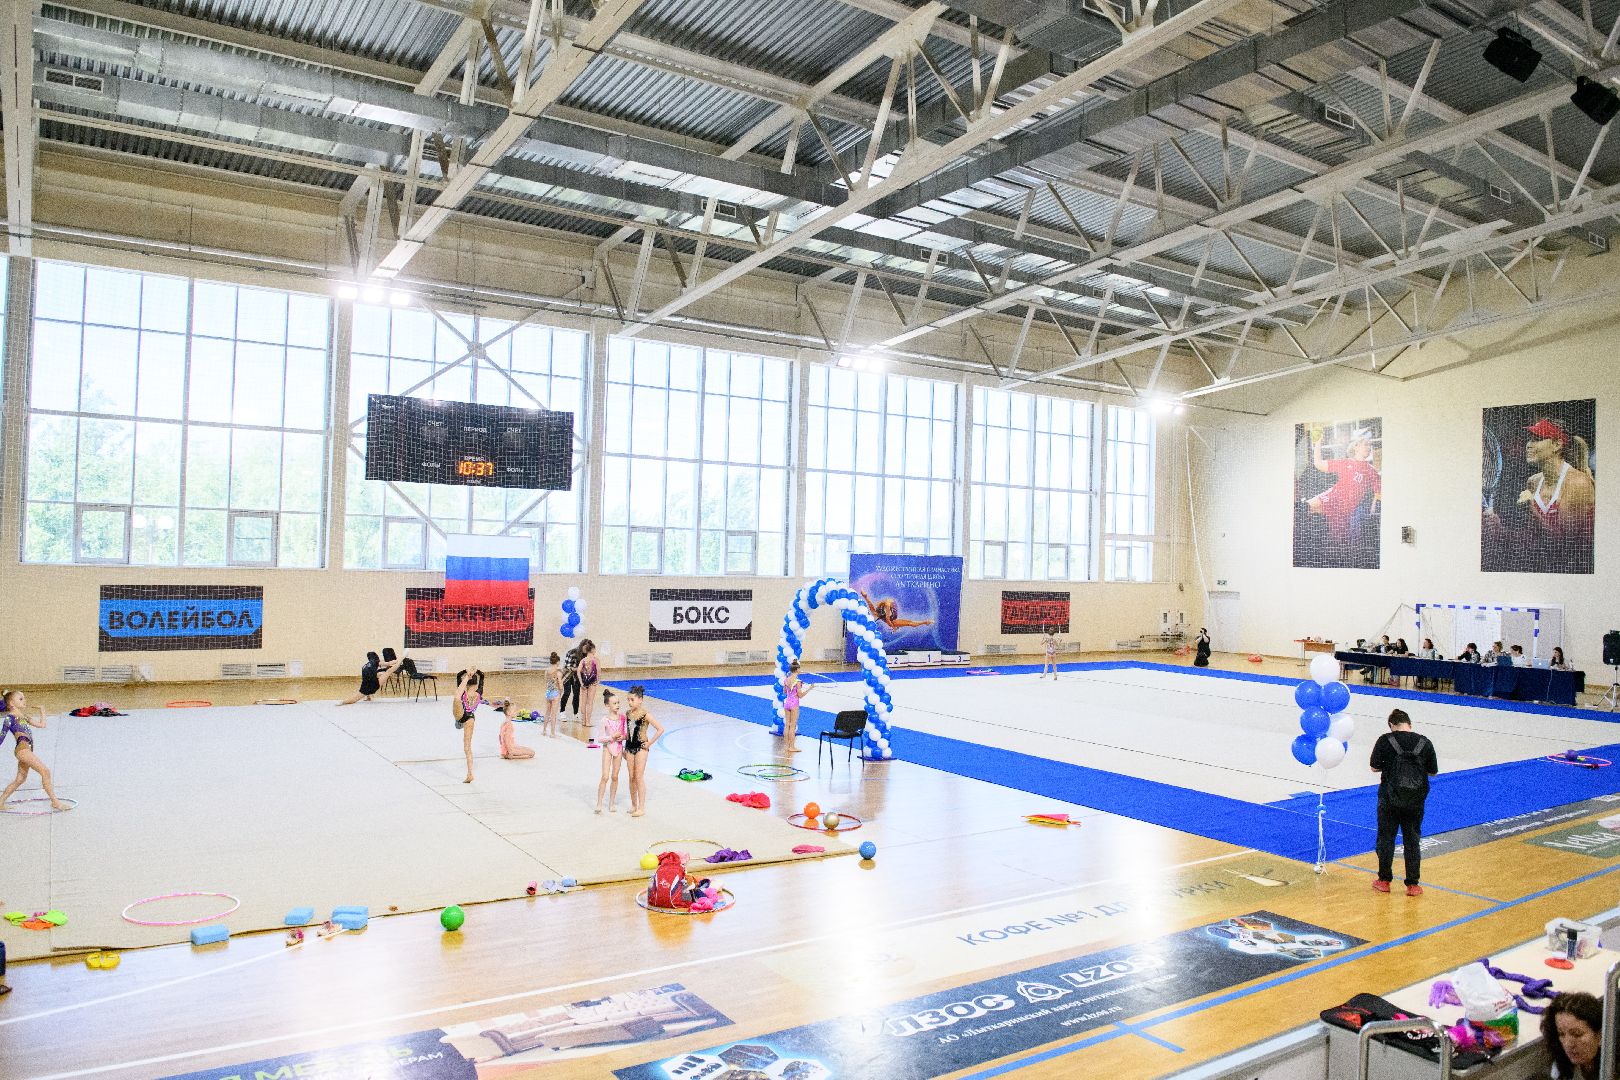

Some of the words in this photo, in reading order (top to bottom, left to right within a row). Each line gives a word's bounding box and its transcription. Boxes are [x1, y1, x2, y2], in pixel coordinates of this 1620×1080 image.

[459, 461, 493, 476] 10:37
[108, 605, 254, 630] ВОЛЕЙБОЛ
[415, 605, 527, 623] БАСКЕТБОЛ
[672, 605, 730, 625] БОКС
[893, 657, 899, 665] 2
[956, 919, 1053, 946] КОФЕ
[1058, 954, 1165, 988] LZOS
[884, 994, 1016, 1037] ЛЗОС
[1060, 1005, 1123, 1027] www.lzos.ru
[938, 1033, 960, 1045] АО
